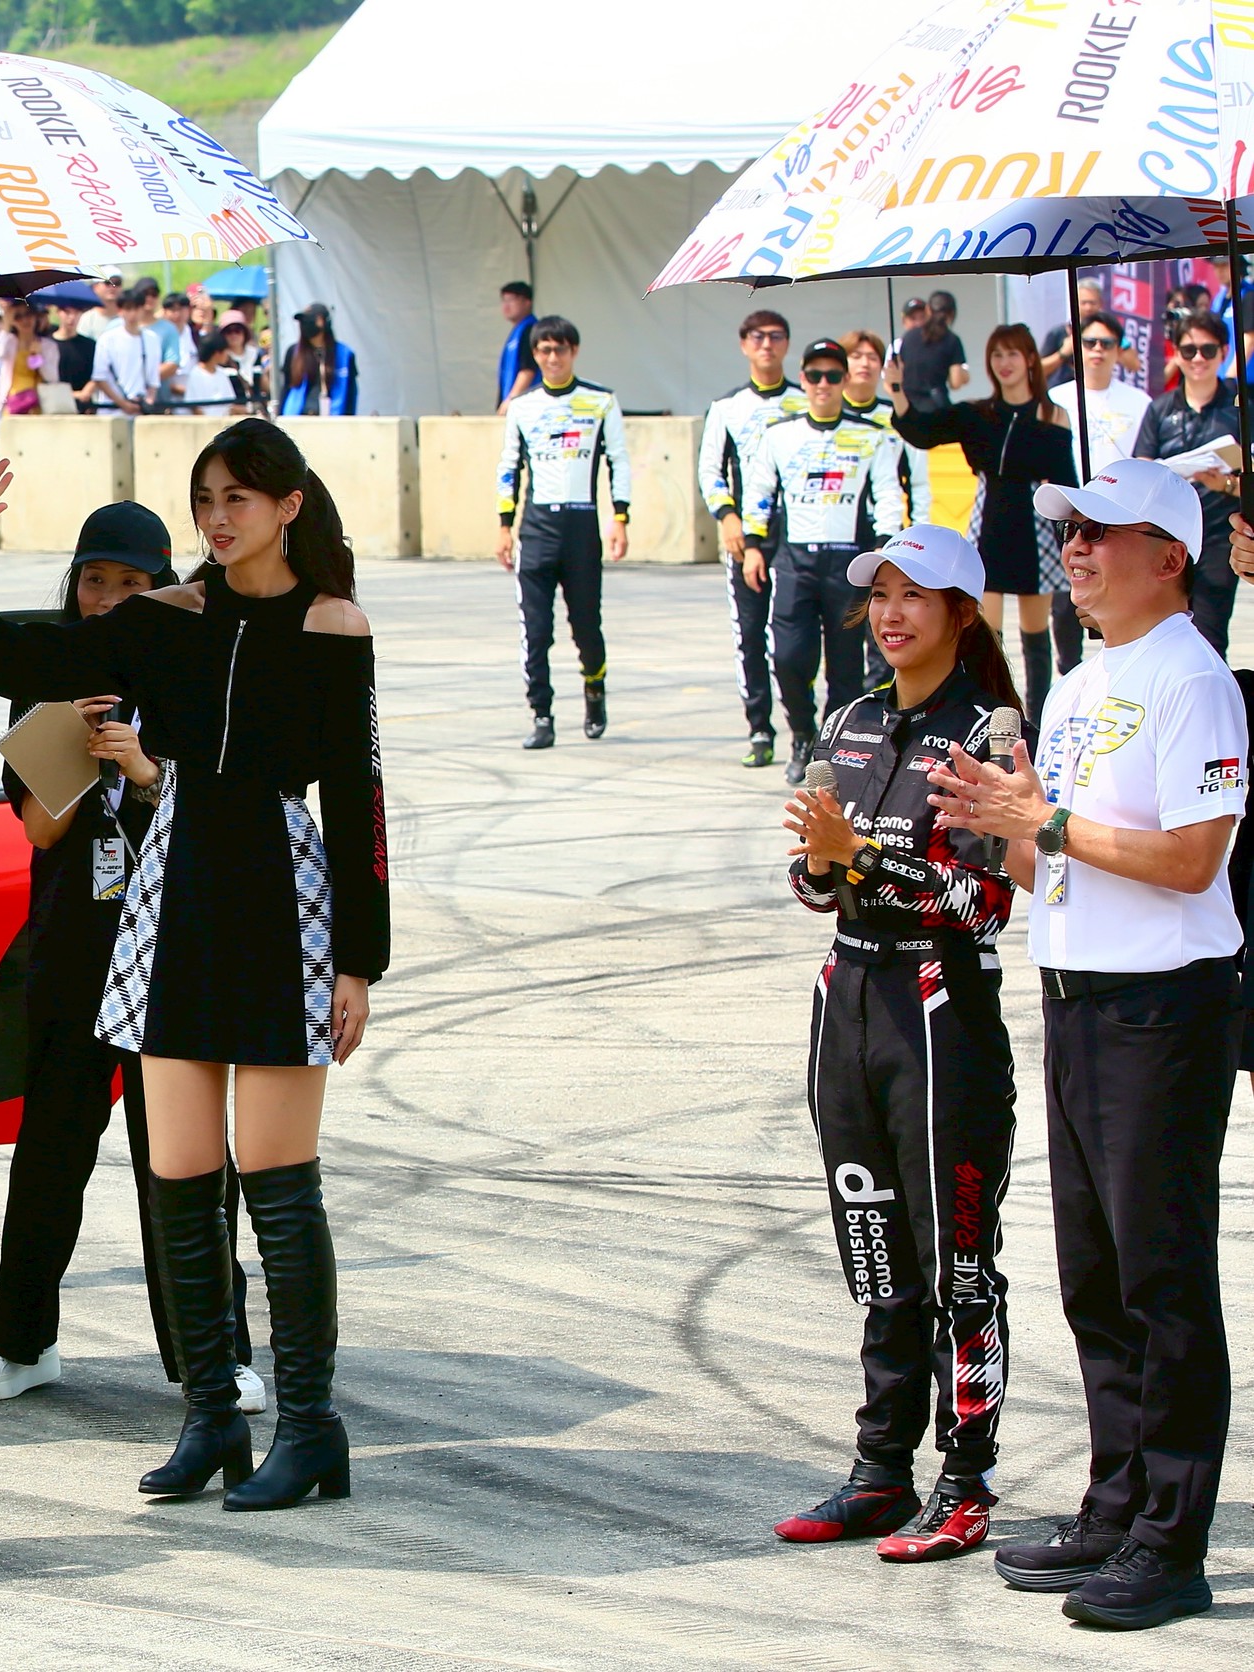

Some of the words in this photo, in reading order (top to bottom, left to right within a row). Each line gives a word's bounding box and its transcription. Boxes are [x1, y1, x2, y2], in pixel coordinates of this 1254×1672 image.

[1057, 12, 1137, 124] ROOKIE
[0, 77, 86, 148] ROOKIE
[57, 152, 138, 253] RACING
[128, 154, 180, 216] ROOKIE
[908, 757, 936, 773] GR
[1205, 764, 1240, 782] GR
[881, 857, 926, 881] sparco
[895, 940, 934, 950] sparco
[954, 1160, 984, 1248] RACING
[846, 1209, 872, 1305] business
[865, 1209, 894, 1298] docomo
